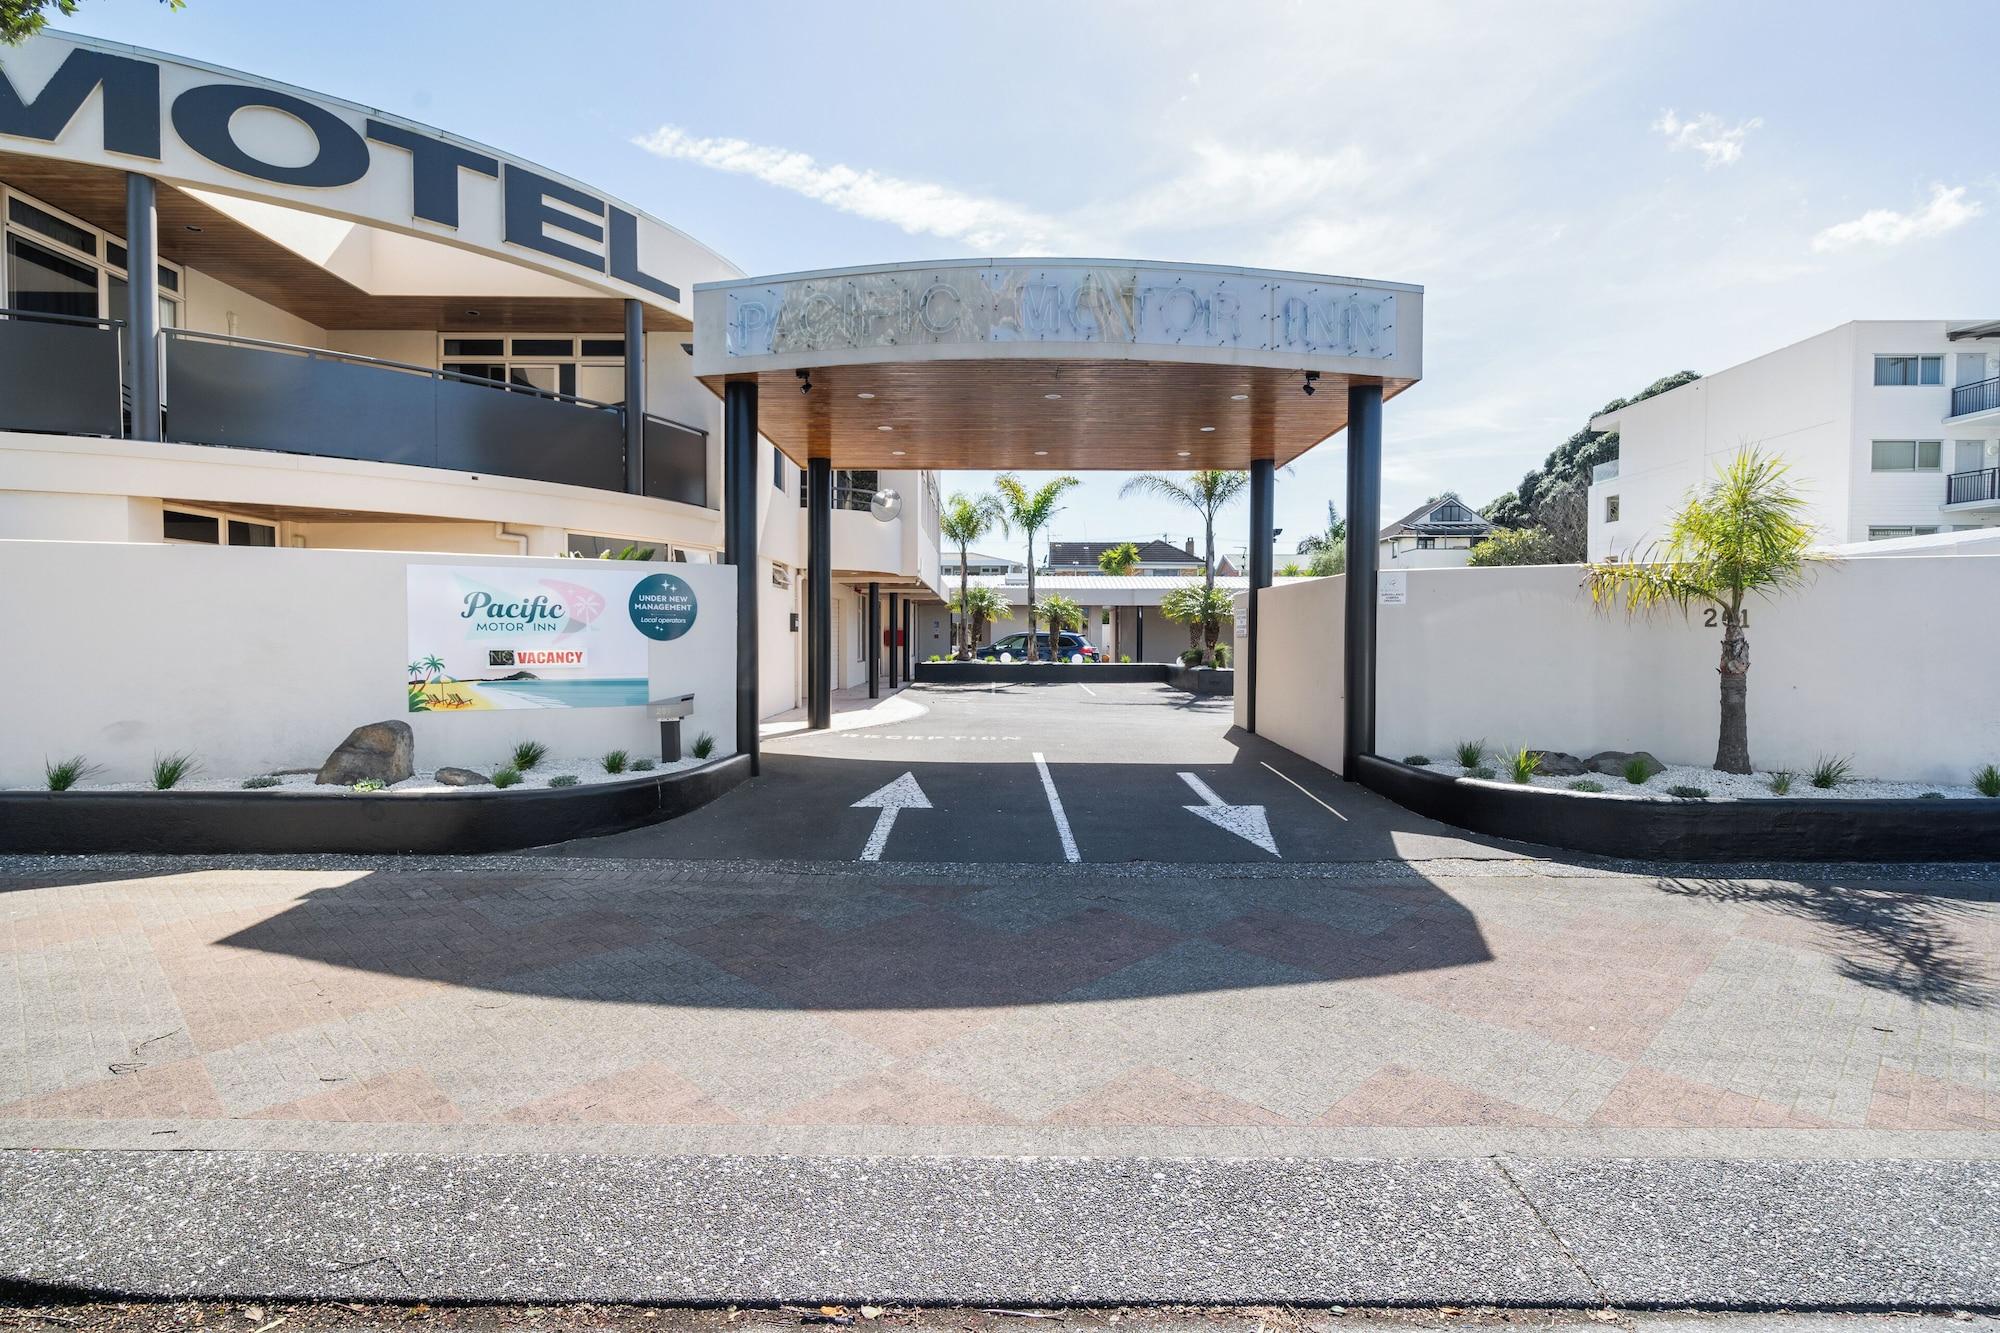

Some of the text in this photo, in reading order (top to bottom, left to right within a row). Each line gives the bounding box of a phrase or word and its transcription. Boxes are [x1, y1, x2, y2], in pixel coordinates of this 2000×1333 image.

[0, 48, 681, 303] MOTEL
[737, 282, 1385, 352] PACIFIC MOTOR INN
[638, 594, 688, 603] UNDER NEW
[461, 591, 565, 623] Pacific
[634, 603, 692, 611] MANAGEMENT
[476, 622, 556, 632] MOTOR INN
[518, 651, 583, 664] VACANCY
[840, 733, 1022, 741] RECEPTION
